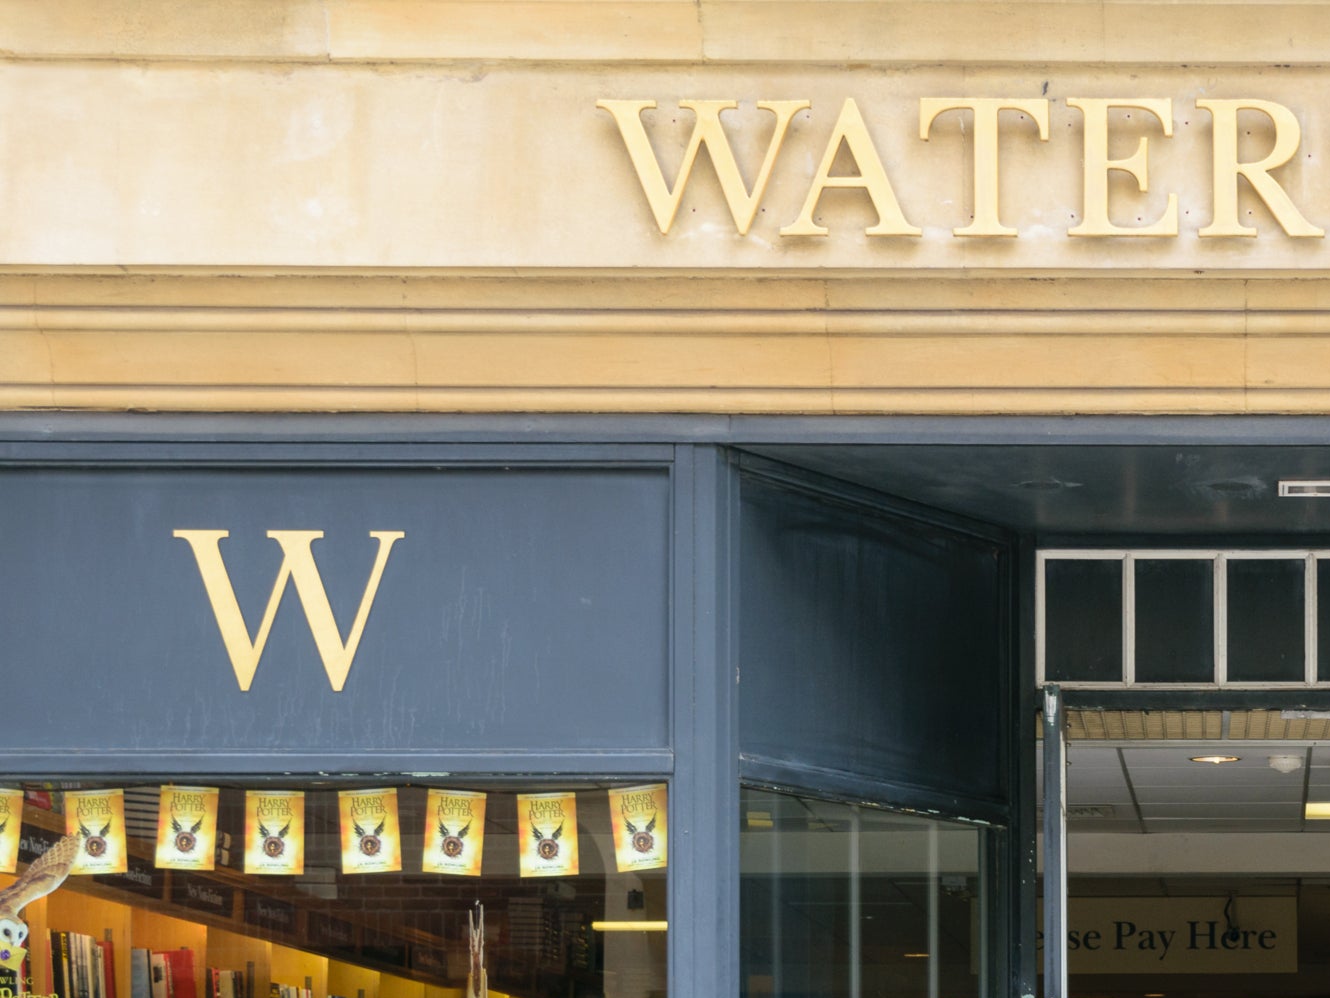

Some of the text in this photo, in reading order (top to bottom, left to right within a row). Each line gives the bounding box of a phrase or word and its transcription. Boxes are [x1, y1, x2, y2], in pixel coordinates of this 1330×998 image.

[172, 529, 405, 691] W
[78, 797, 111, 808] HARRY
[173, 793, 206, 803] HARRY
[259, 797, 292, 808] HARRY
[352, 796, 385, 808] HARRY
[441, 797, 474, 809] HARRY
[621, 793, 655, 804] HARRY
[170, 801, 206, 812] POTTER
[351, 805, 388, 817] POTTER
[437, 805, 474, 817] POTTER
[530, 800, 564, 811] HARRY
[621, 801, 658, 814] POTTER
[77, 806, 113, 817] POTTER
[257, 806, 293, 817] POTTER
[528, 808, 565, 820] POTTER
[1113, 921, 1277, 960] Pay Here
